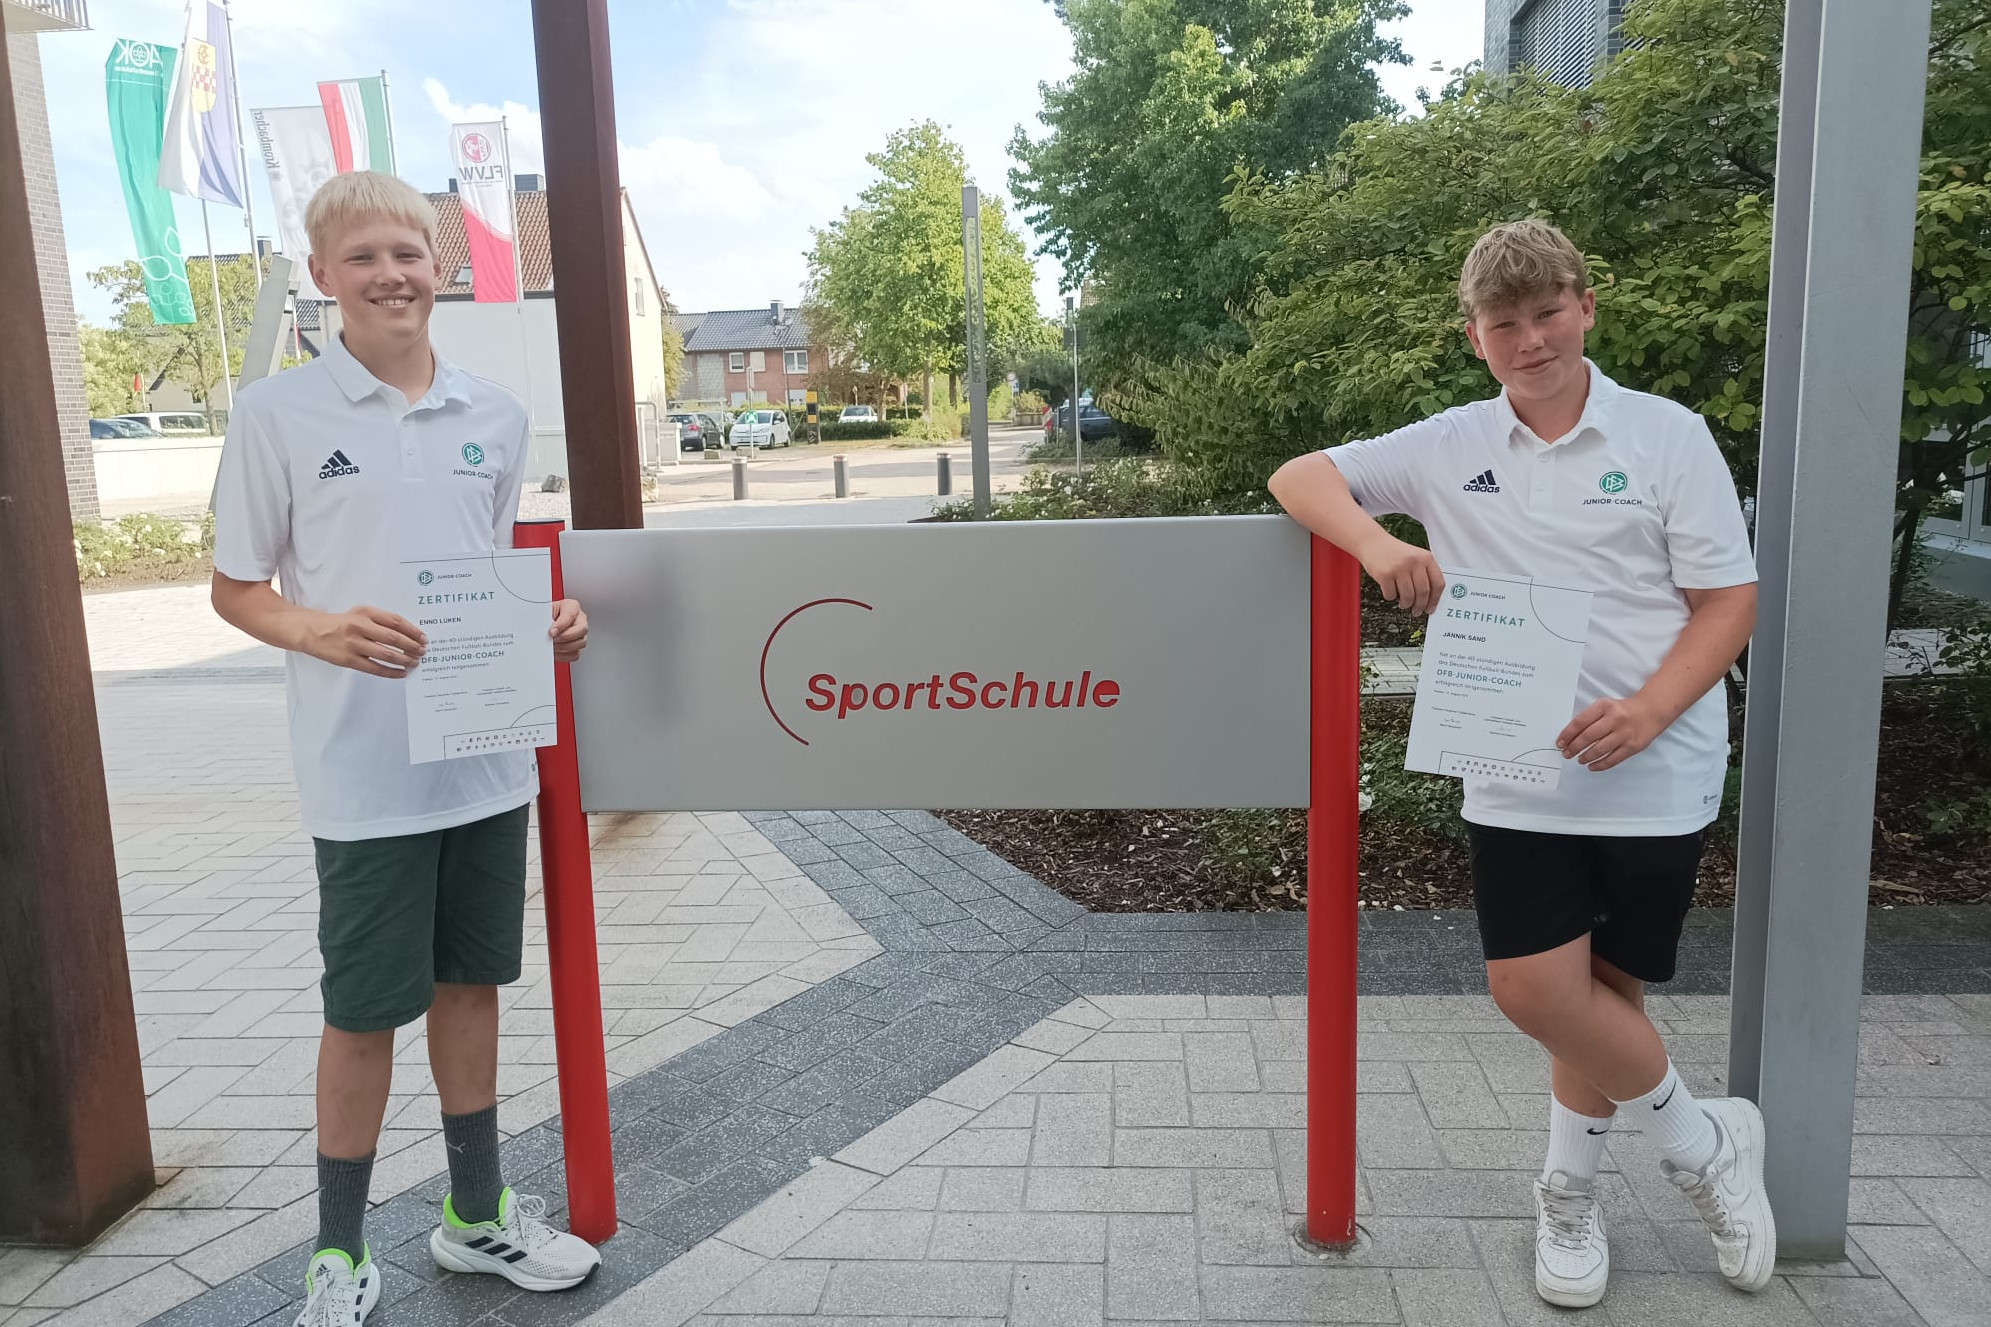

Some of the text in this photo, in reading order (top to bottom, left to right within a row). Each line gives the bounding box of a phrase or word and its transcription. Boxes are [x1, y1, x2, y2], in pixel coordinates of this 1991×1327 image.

[318, 465, 360, 480] adidas
[1463, 483, 1500, 494] adidas
[418, 591, 495, 605] ZERTIFIKAT
[419, 618, 438, 626] ENNO
[1446, 608, 1526, 627] ZERTIFIKAT
[1442, 632, 1486, 643] JANNIK SAND
[421, 650, 505, 664] DFB-JUNIOR-COACH
[1436, 668, 1522, 688] DFB-JUNIOR-COACH
[805, 670, 1121, 719] SportSchule
